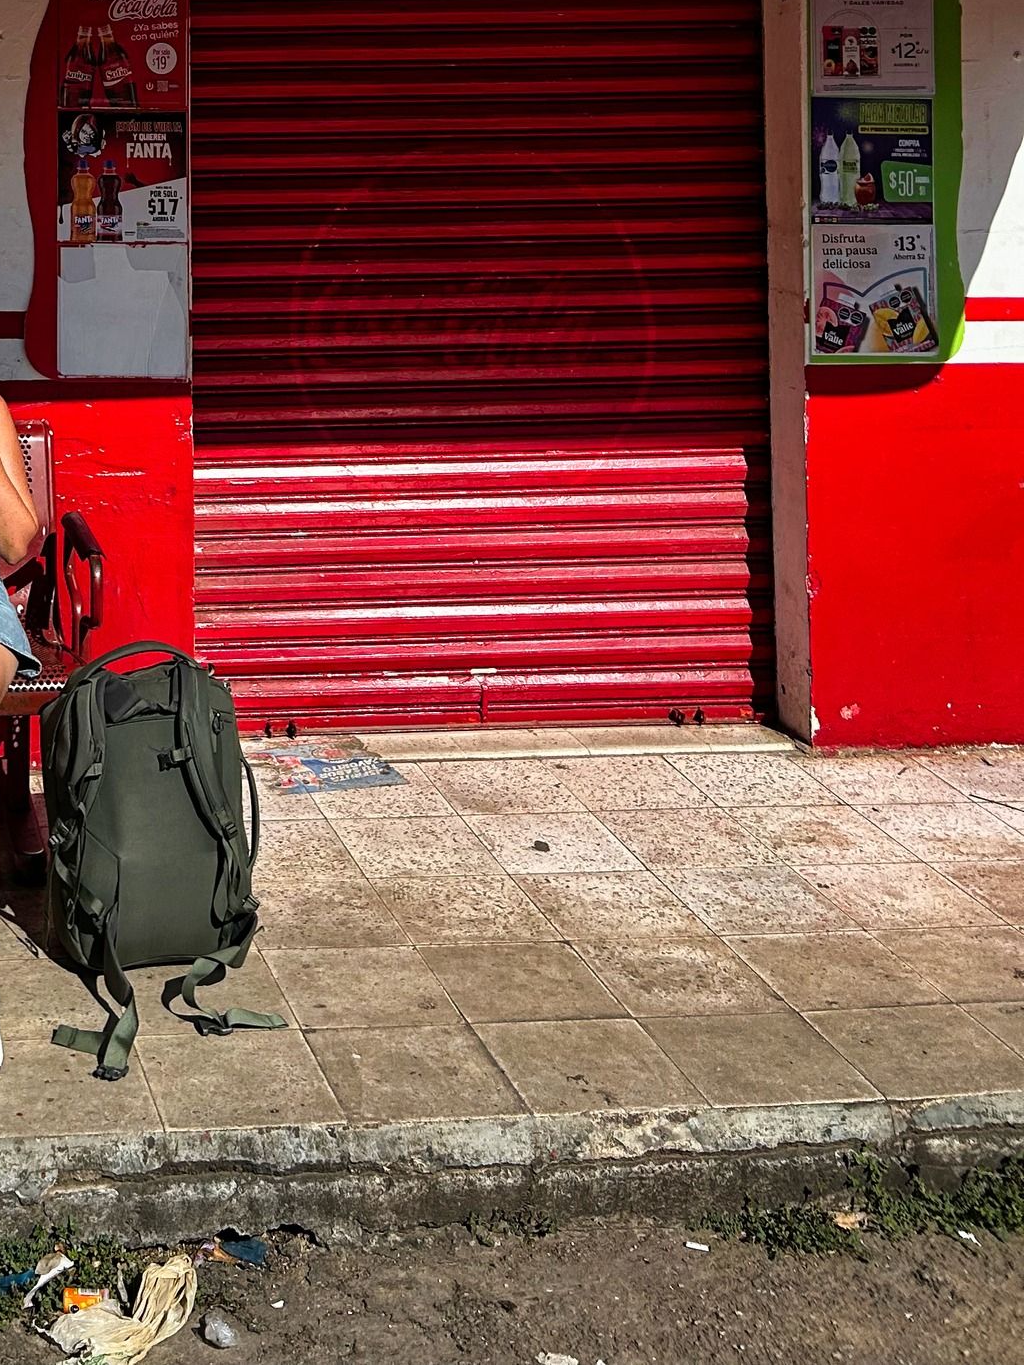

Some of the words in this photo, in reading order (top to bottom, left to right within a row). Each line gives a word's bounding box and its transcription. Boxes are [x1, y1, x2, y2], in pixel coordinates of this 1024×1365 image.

[151, 21, 179, 30] sabes
[140, 133, 167, 143] QUIEREN
[126, 142, 173, 159] FANTA
[150, 190, 162, 198] POR
[163, 190, 178, 198] SOLO
[822, 233, 866, 244] Disfruta
[822, 247, 843, 256] una
[845, 246, 878, 258] pausa
[893, 253, 916, 261] Ahorra
[917, 253, 926, 261] $2
[822, 259, 871, 270] deliciosa
[893, 323, 915, 336] Valle
[823, 332, 844, 346] Valle
